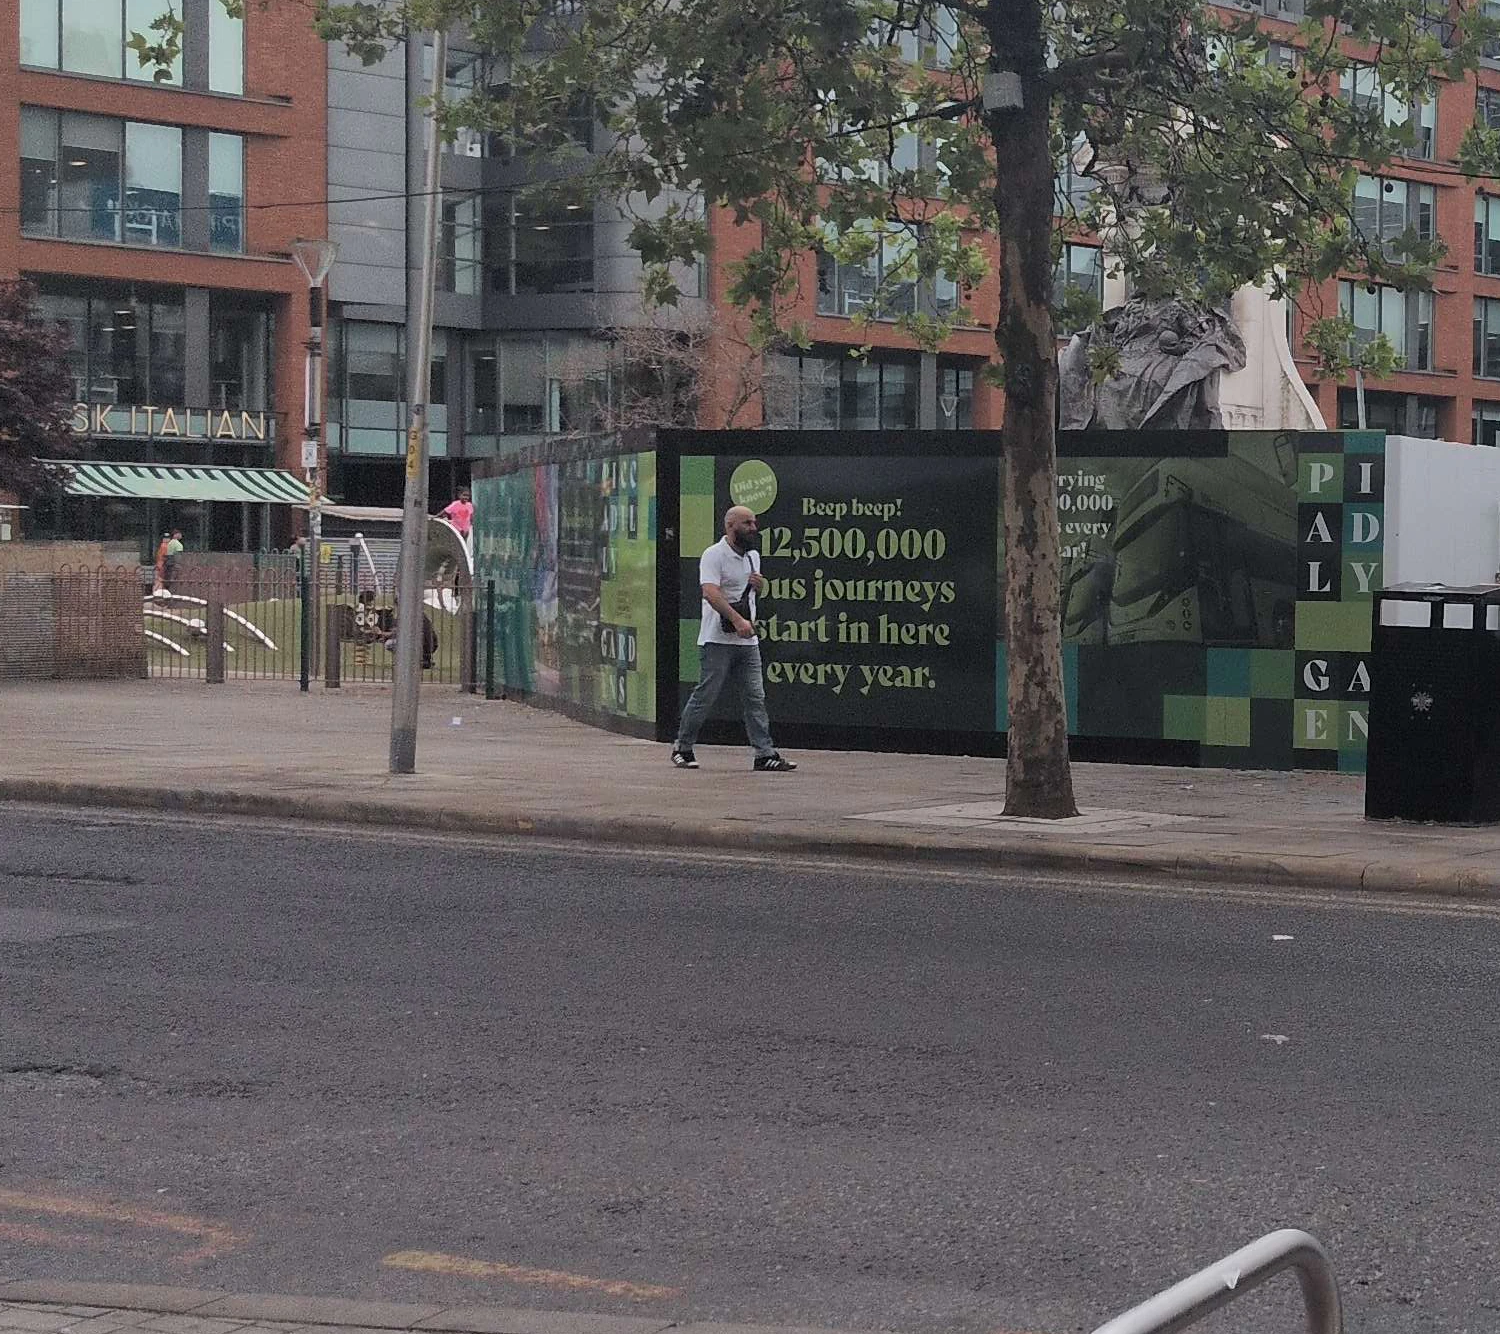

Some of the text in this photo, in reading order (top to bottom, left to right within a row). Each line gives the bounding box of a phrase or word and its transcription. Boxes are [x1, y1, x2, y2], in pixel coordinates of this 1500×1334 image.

[73, 403, 264, 440] SK ITALIAN
[734, 474, 773, 494] Did you
[1056, 470, 1106, 491] rying
[739, 486, 772, 504] know?
[1056, 493, 1113, 514] 0,000
[802, 497, 903, 522] Beep beep!
[1066, 522, 1111, 539] every
[758, 526, 946, 566] 12,500,000
[1058, 541, 1087, 558] ar!
[811, 569, 956, 612] journeys
[754, 611, 951, 646] start in here
[766, 661, 936, 696] every year.
